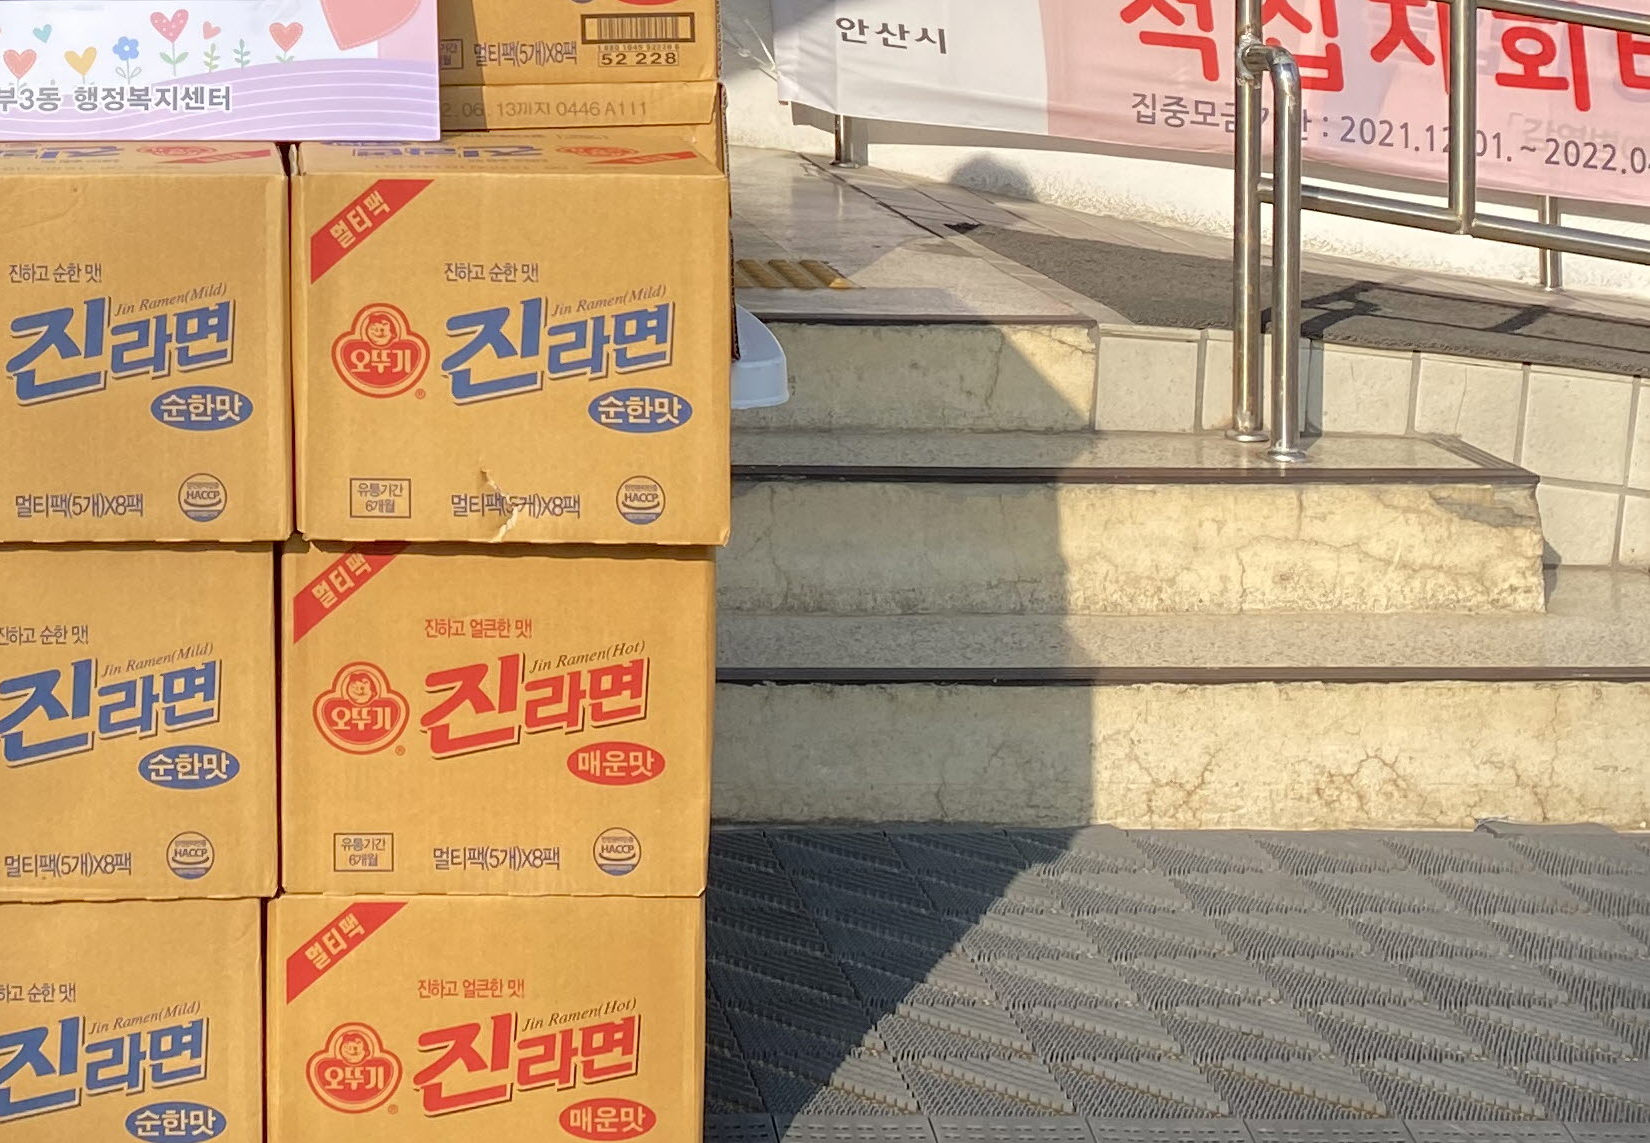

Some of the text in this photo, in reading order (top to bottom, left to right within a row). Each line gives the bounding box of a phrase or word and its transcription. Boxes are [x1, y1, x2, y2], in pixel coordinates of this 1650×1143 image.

[835, 16, 947, 55] 안산시
[74, 84, 231, 114] 행정복지센터
[1545, 138, 1650, 174] 2022.0
[330, 190, 390, 249] 멀티팩
[8, 263, 49, 283] 진하고
[53, 263, 82, 282] 순한
[444, 262, 485, 282] 진하고
[489, 262, 517, 282] 순한
[115, 303, 135, 318] Jin
[552, 302, 571, 316] Jin
[5, 295, 236, 407] 진라면
[350, 349, 412, 374] 오뚜기
[441, 296, 675, 405] 진라면
[160, 394, 243, 423] 순한맛
[598, 396, 682, 425] 순한맛
[357, 482, 403, 498] 유통기간
[311, 550, 372, 609] 멀티팩
[425, 618, 465, 639] 진하고
[469, 618, 512, 639] 얼큰한
[330, 705, 392, 732] 오뚜기
[420, 652, 650, 760] 진라면
[147, 753, 230, 782] 순한맛
[577, 749, 654, 777] 매운맛
[304, 912, 366, 971] 멀티팩
[324, 1065, 385, 1092] 오뚜기
[412, 1012, 641, 1118] 진라면
[135, 1109, 217, 1137] 순한맛
[570, 1106, 646, 1134] 매운맛
